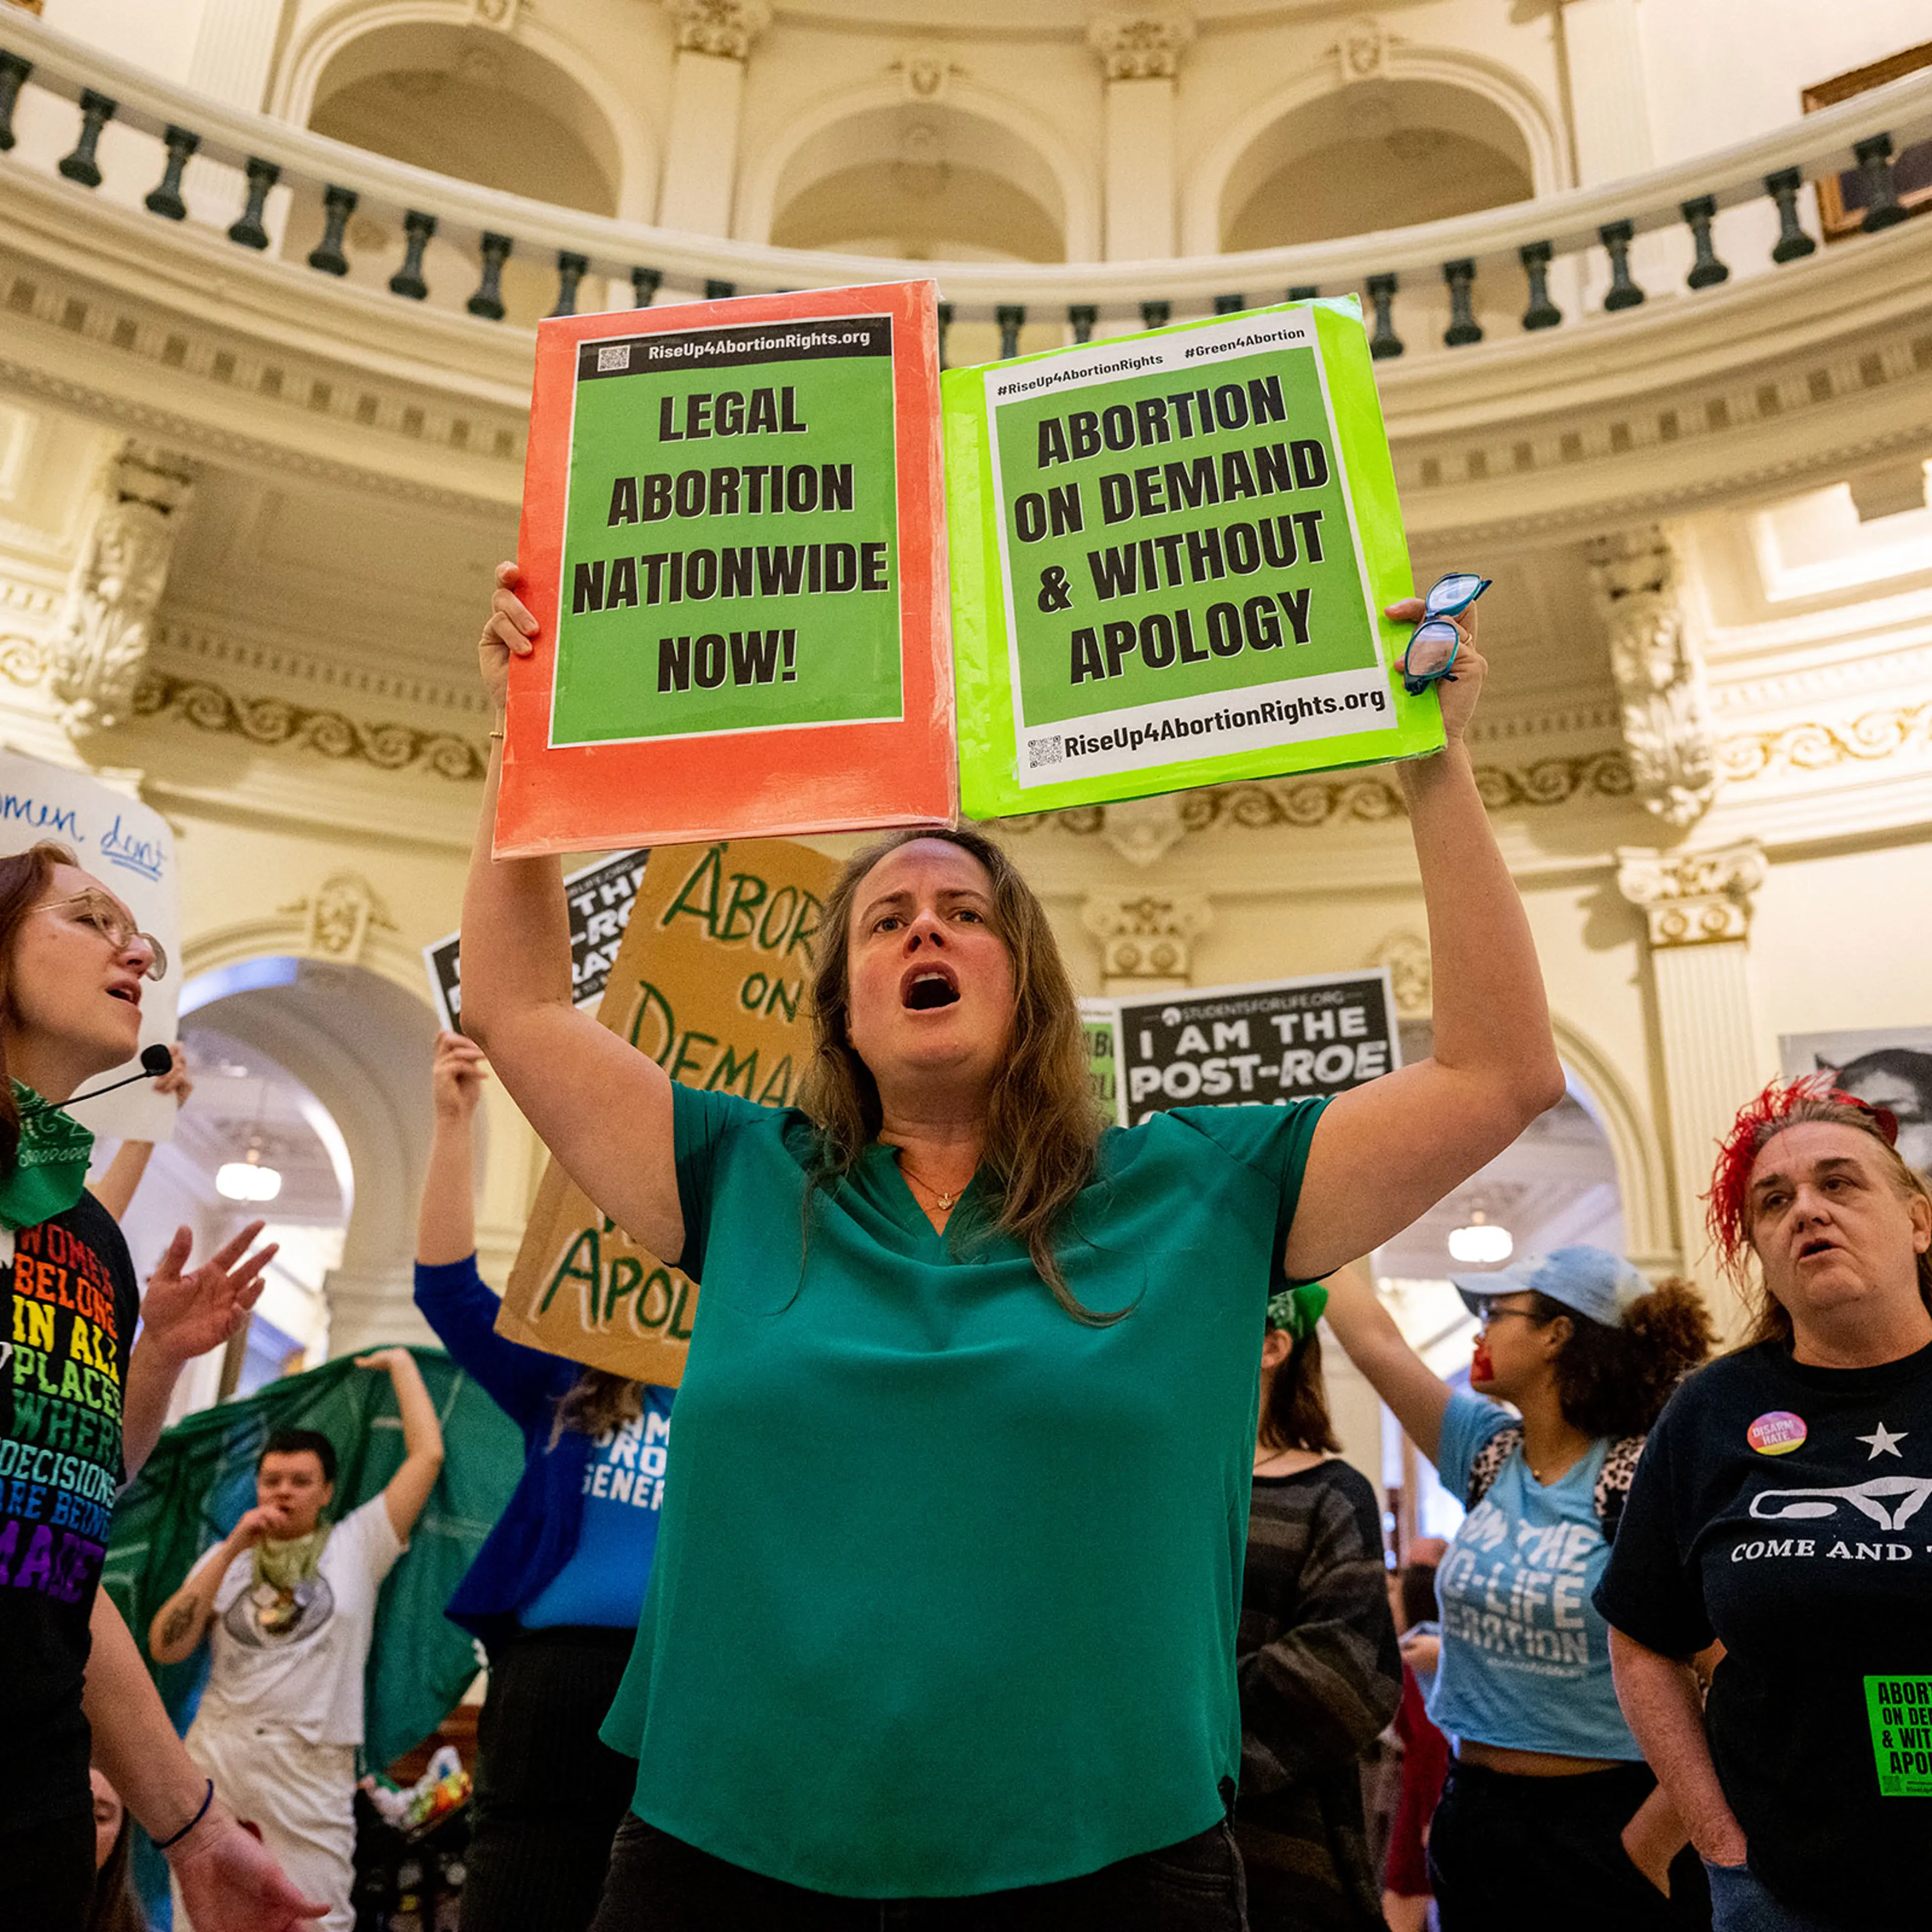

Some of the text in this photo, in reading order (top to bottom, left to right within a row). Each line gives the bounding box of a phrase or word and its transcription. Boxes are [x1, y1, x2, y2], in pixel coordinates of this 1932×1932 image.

[648, 331, 870, 361] RiseUp4AbortionRights.org
[997, 327, 1306, 396] #RiseUp4AbortionRights #Green4Abortion
[659, 385, 808, 443] LEGAL
[1037, 375, 1288, 469] ABORTION
[607, 464, 854, 528] ABORTION
[1014, 439, 1331, 544] ON DEMAND
[572, 542, 890, 615] NATIONWIDE
[1037, 510, 1325, 614] & WITHOUT
[658, 629, 798, 694] NOW!
[1070, 588, 1312, 686] APOLOGY
[1065, 689, 1386, 759] RiseUp4AbortionRights.org
[0, 793, 85, 842] men
[741, 972, 803, 1022] ON
[630, 980, 802, 1107] DEMA
[1140, 1029, 1153, 1059] I
[1175, 1019, 1251, 1056] AM
[1270, 1006, 1369, 1045] THE
[1130, 1040, 1389, 1103] POST-ROE
[14, 1252, 119, 1340] BELONG
[12, 1294, 120, 1385] IN ALL
[1752, 1419, 1794, 1437] DISARM
[1762, 1430, 1791, 1446] HATE
[1731, 1539, 1913, 1562] COME AND
[1882, 1707, 1904, 1726] ON
[1882, 1729, 1894, 1749] &
